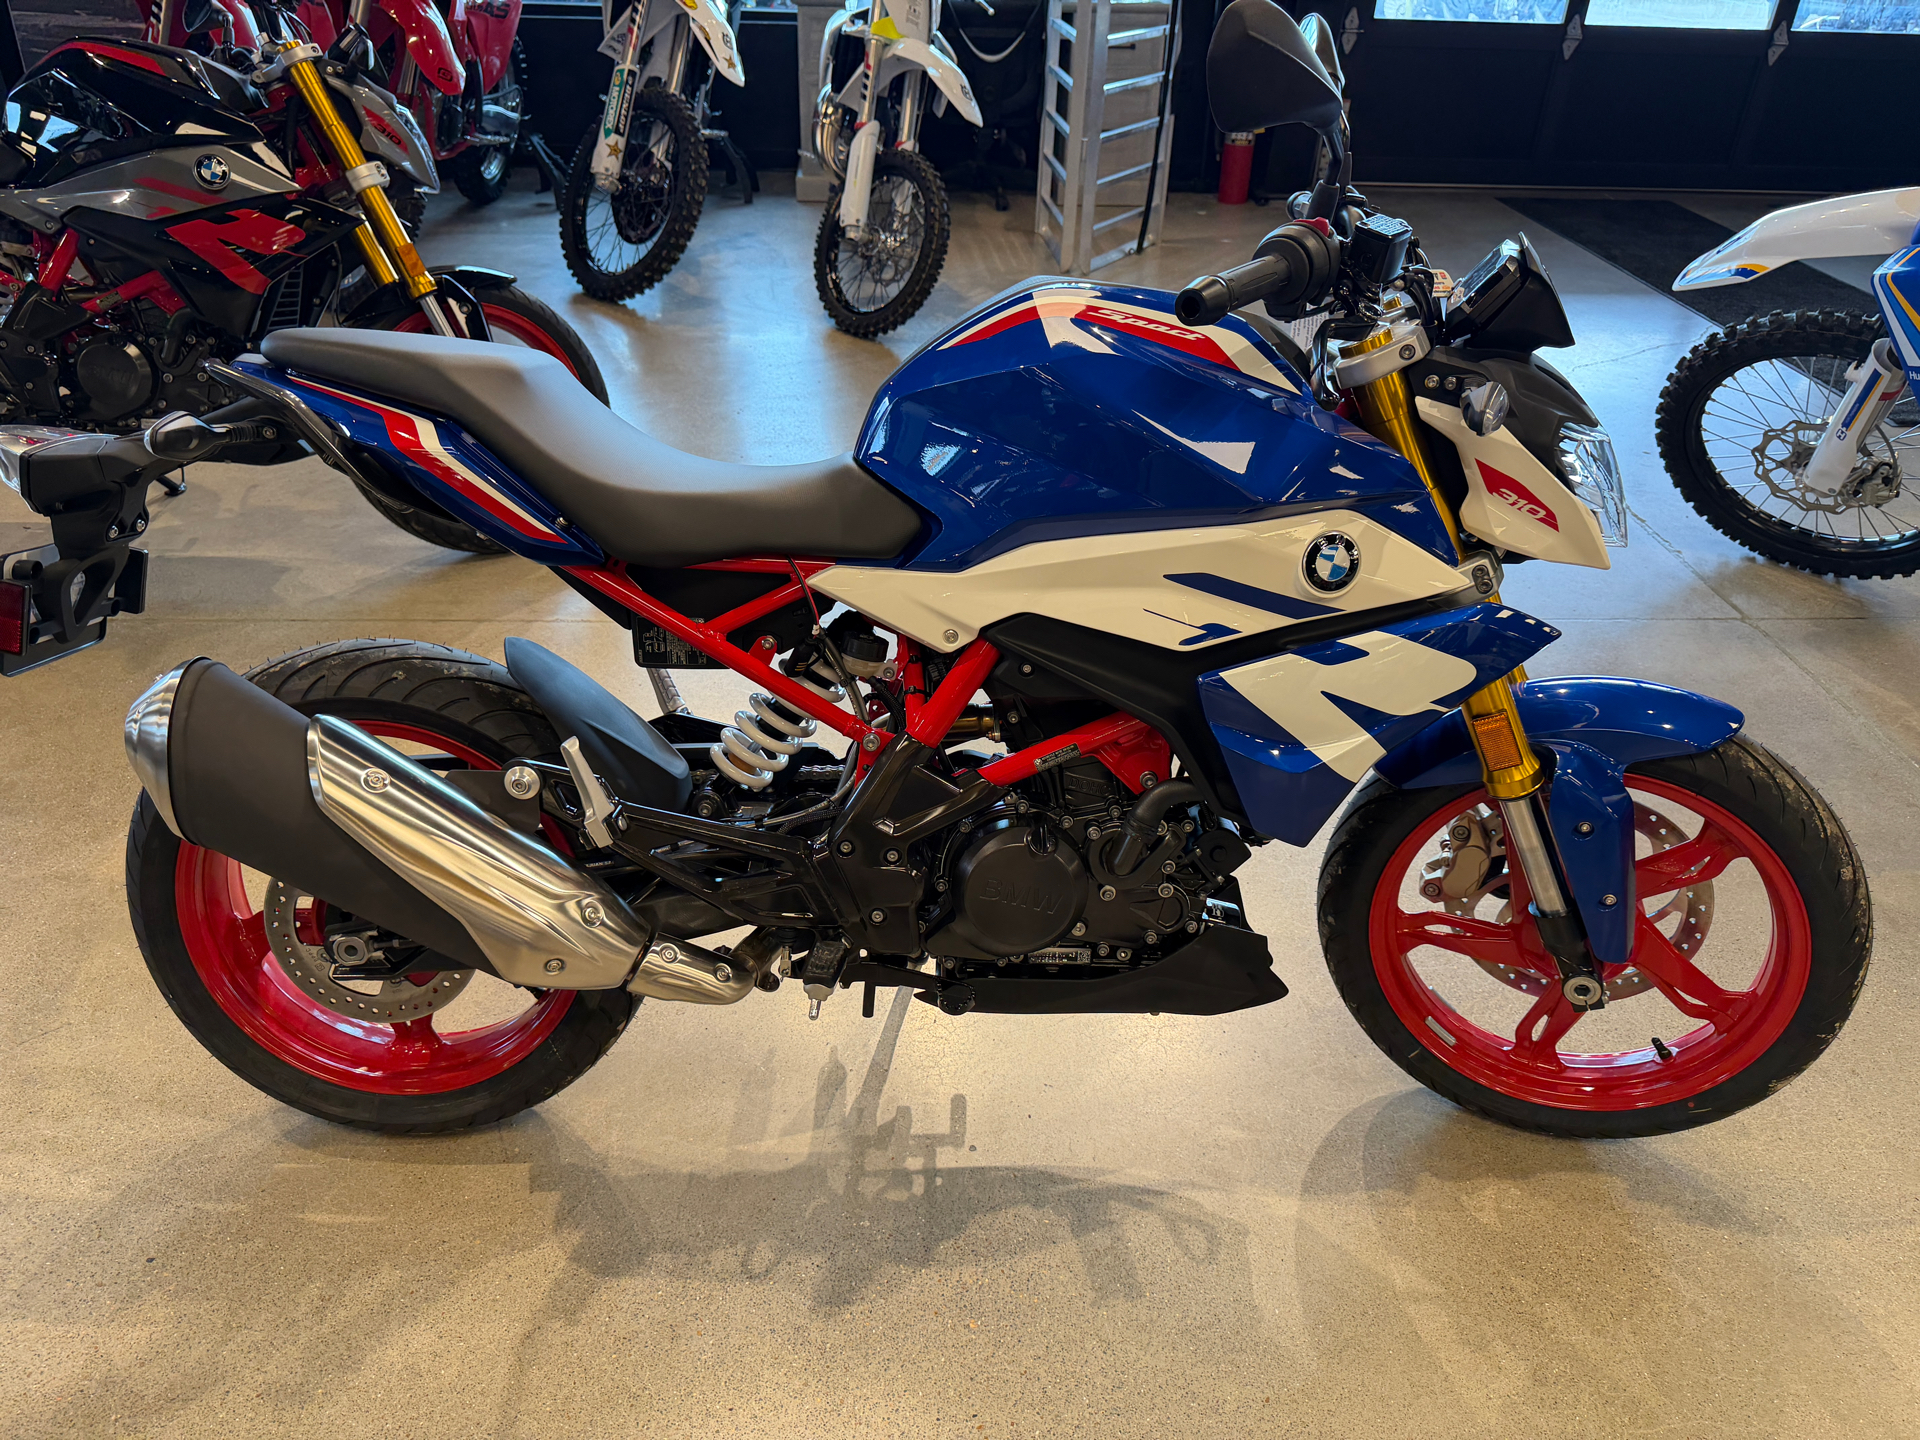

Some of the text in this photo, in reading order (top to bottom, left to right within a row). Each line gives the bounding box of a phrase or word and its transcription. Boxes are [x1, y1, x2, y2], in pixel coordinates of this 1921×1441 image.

[604, 86, 620, 130] MOTOREX
[373, 123, 402, 146] 310
[1086, 308, 1206, 341] Sport
[1492, 488, 1547, 519] 310
[1067, 778, 1113, 797] DOHC
[979, 877, 1065, 916] BMW
